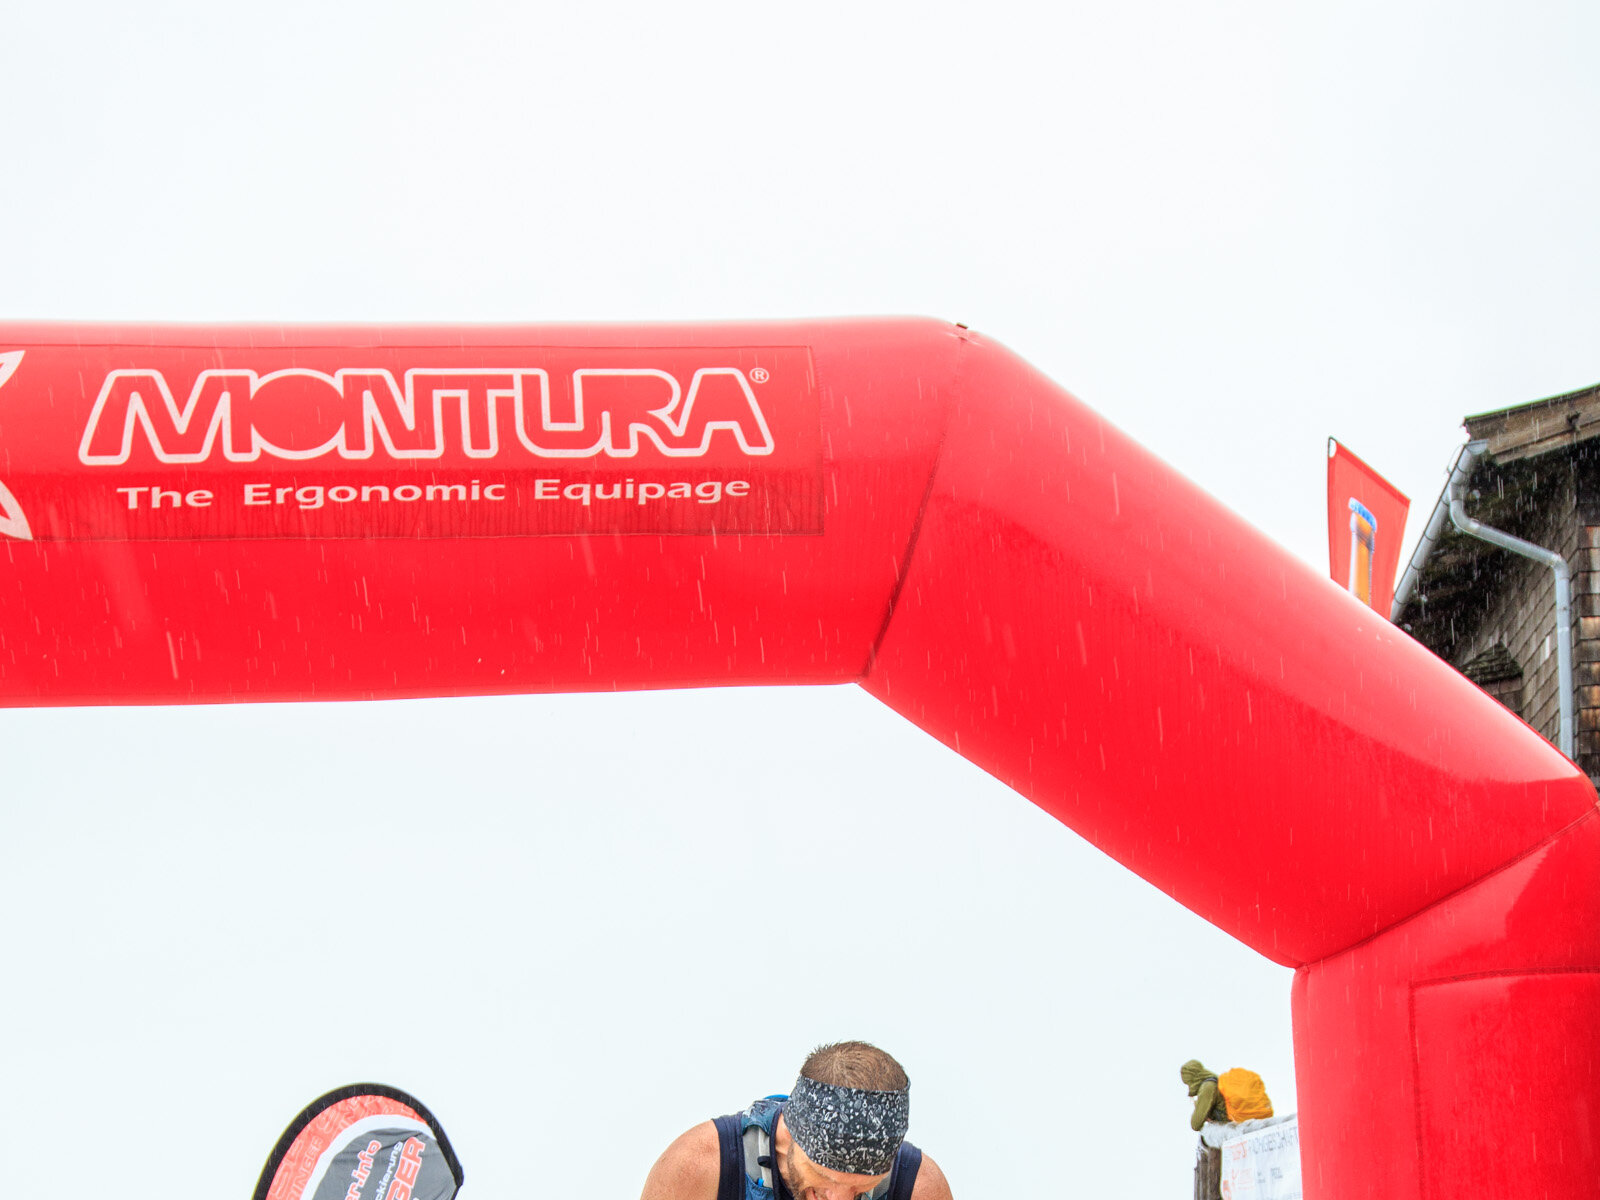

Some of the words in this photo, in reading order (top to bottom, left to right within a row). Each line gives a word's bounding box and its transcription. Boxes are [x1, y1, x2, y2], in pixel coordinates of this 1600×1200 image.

[116, 486, 215, 511] The
[243, 479, 506, 511] Ergonomic
[534, 478, 751, 506] Equipage
